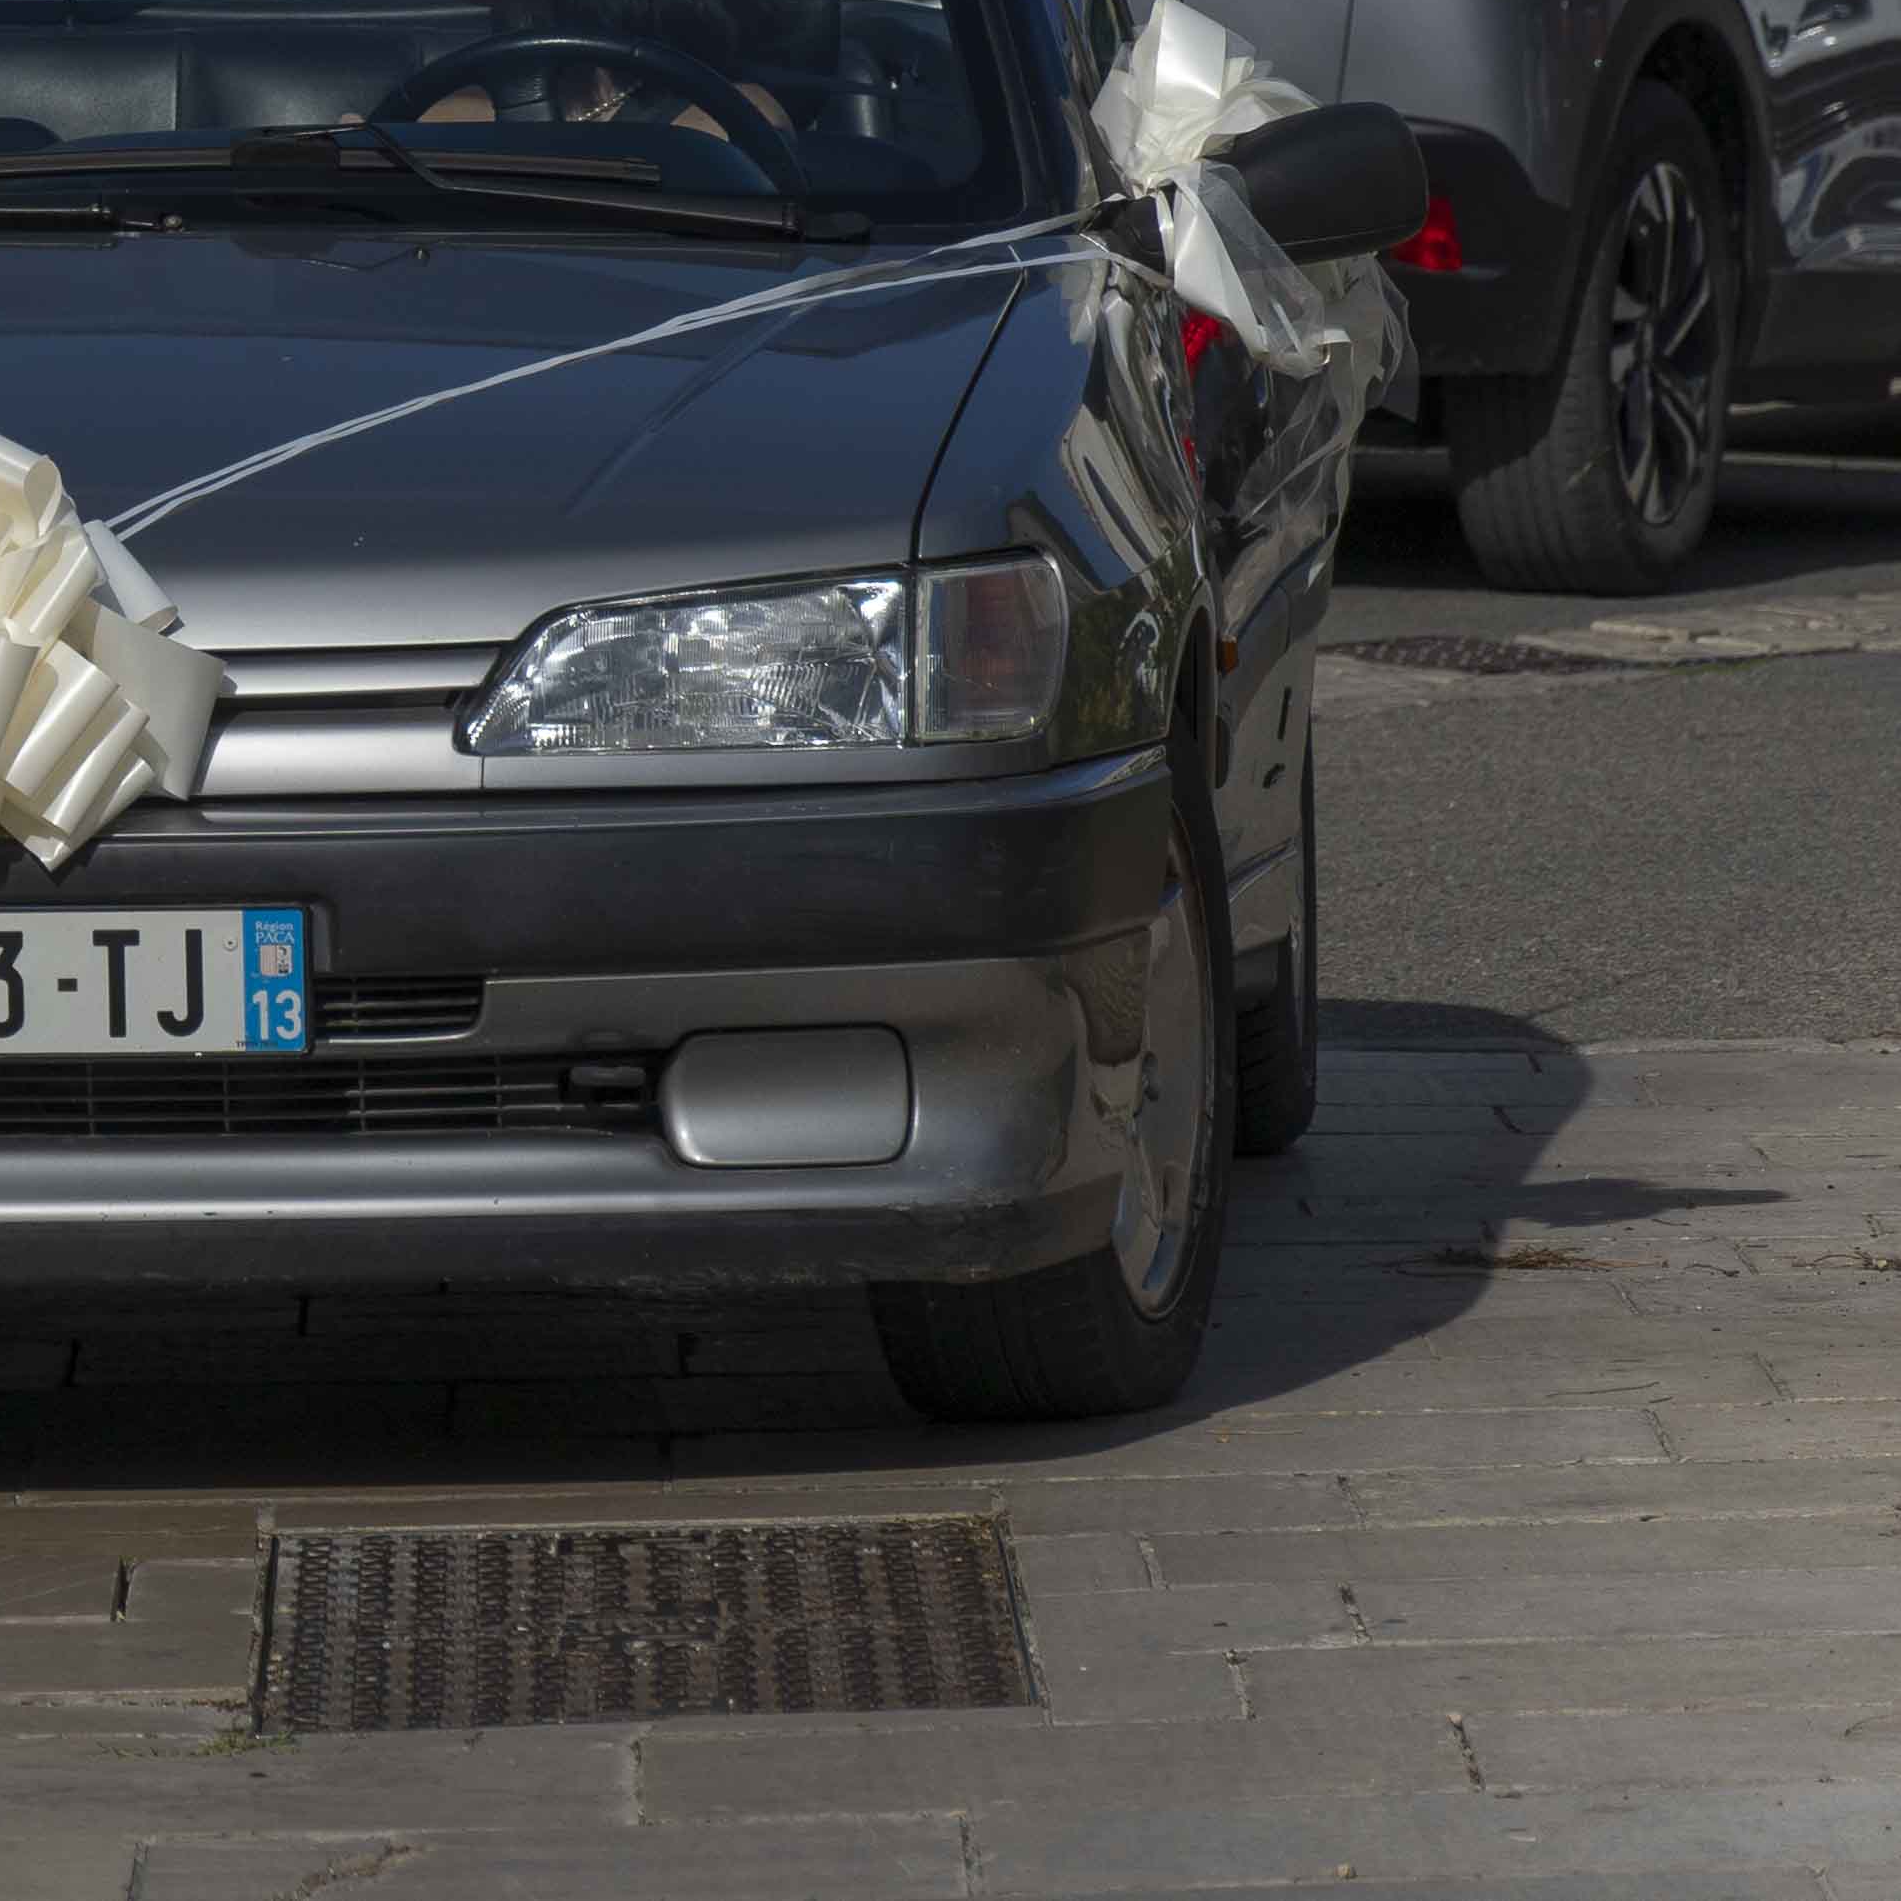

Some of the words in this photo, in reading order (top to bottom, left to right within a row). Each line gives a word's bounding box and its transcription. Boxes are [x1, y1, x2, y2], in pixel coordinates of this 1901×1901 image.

[255, 921, 294, 933] Région
[255, 932, 295, 944] PACA
[251, 988, 303, 1041] 13
